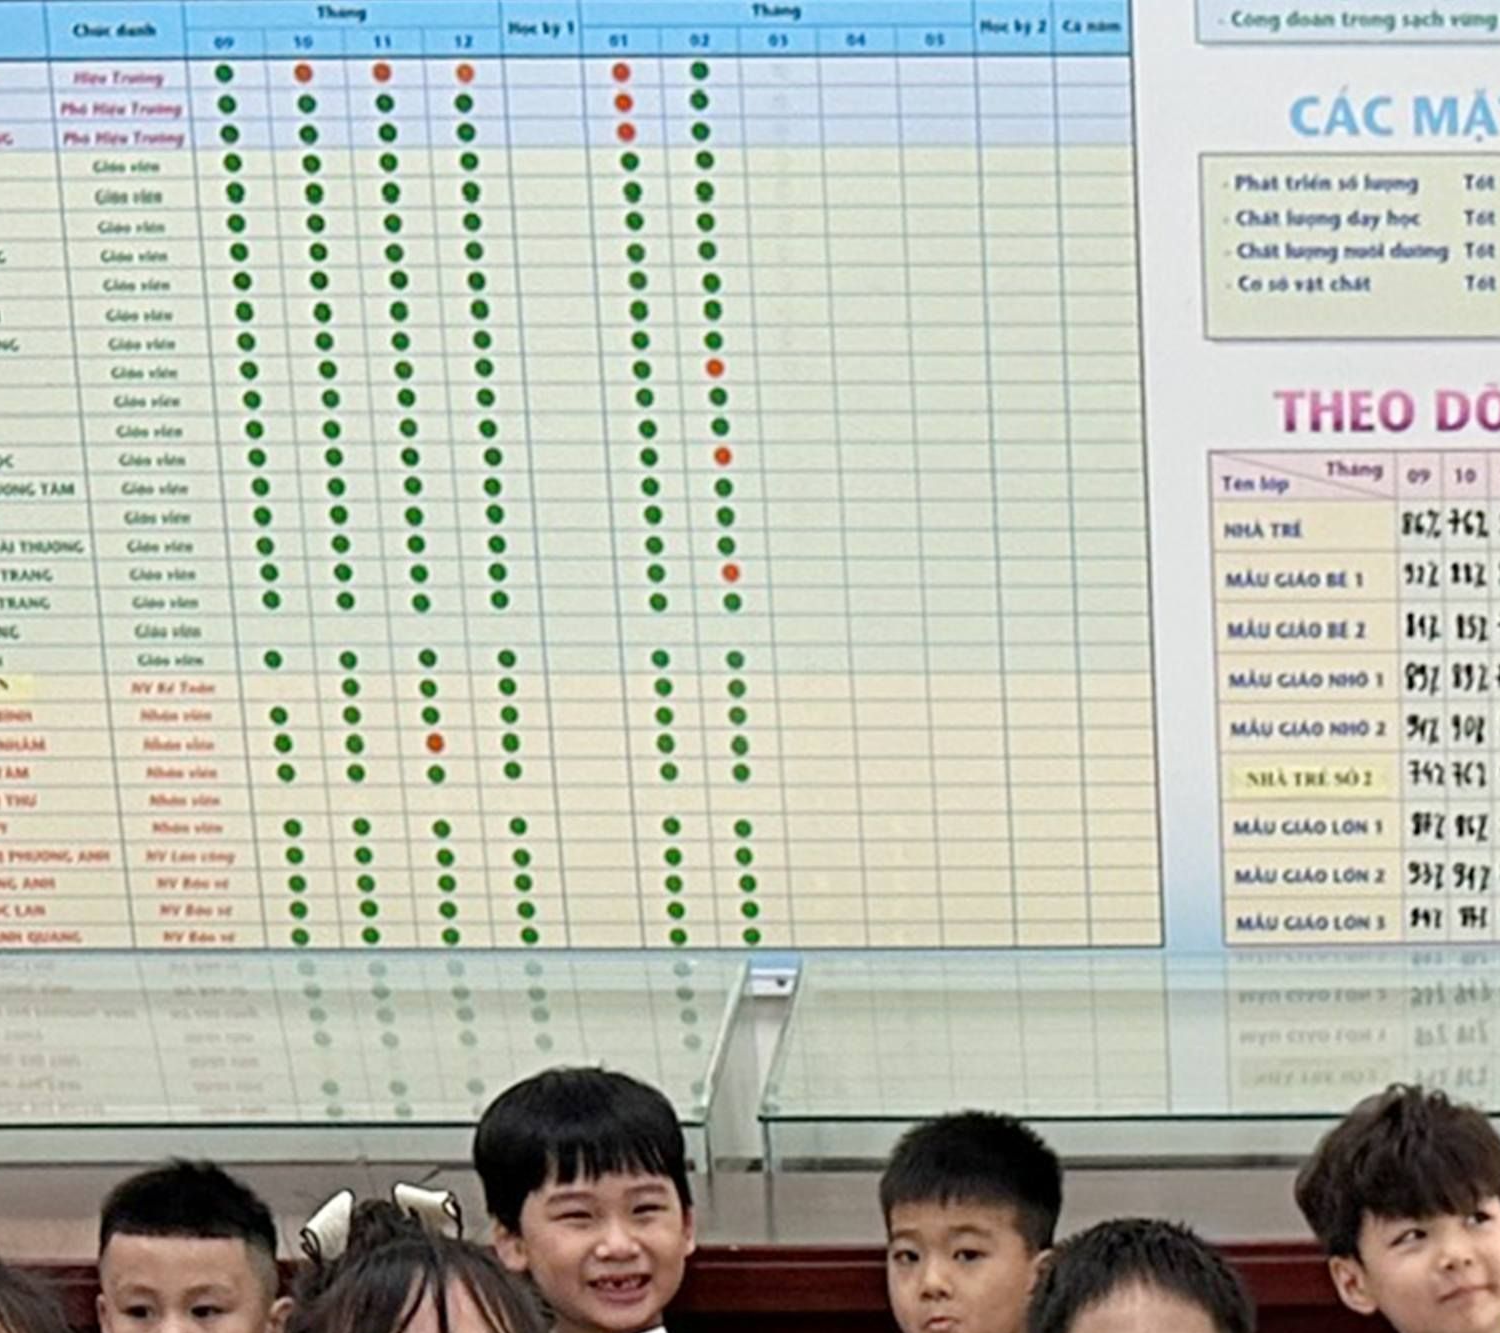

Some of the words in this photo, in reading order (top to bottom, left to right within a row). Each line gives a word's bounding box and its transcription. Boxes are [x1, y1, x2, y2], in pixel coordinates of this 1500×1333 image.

[1290, 85, 1393, 136] CÁC
[1273, 389, 1415, 433] THEO
[1407, 468, 1431, 483] 09
[1455, 468, 1476, 483] 10
